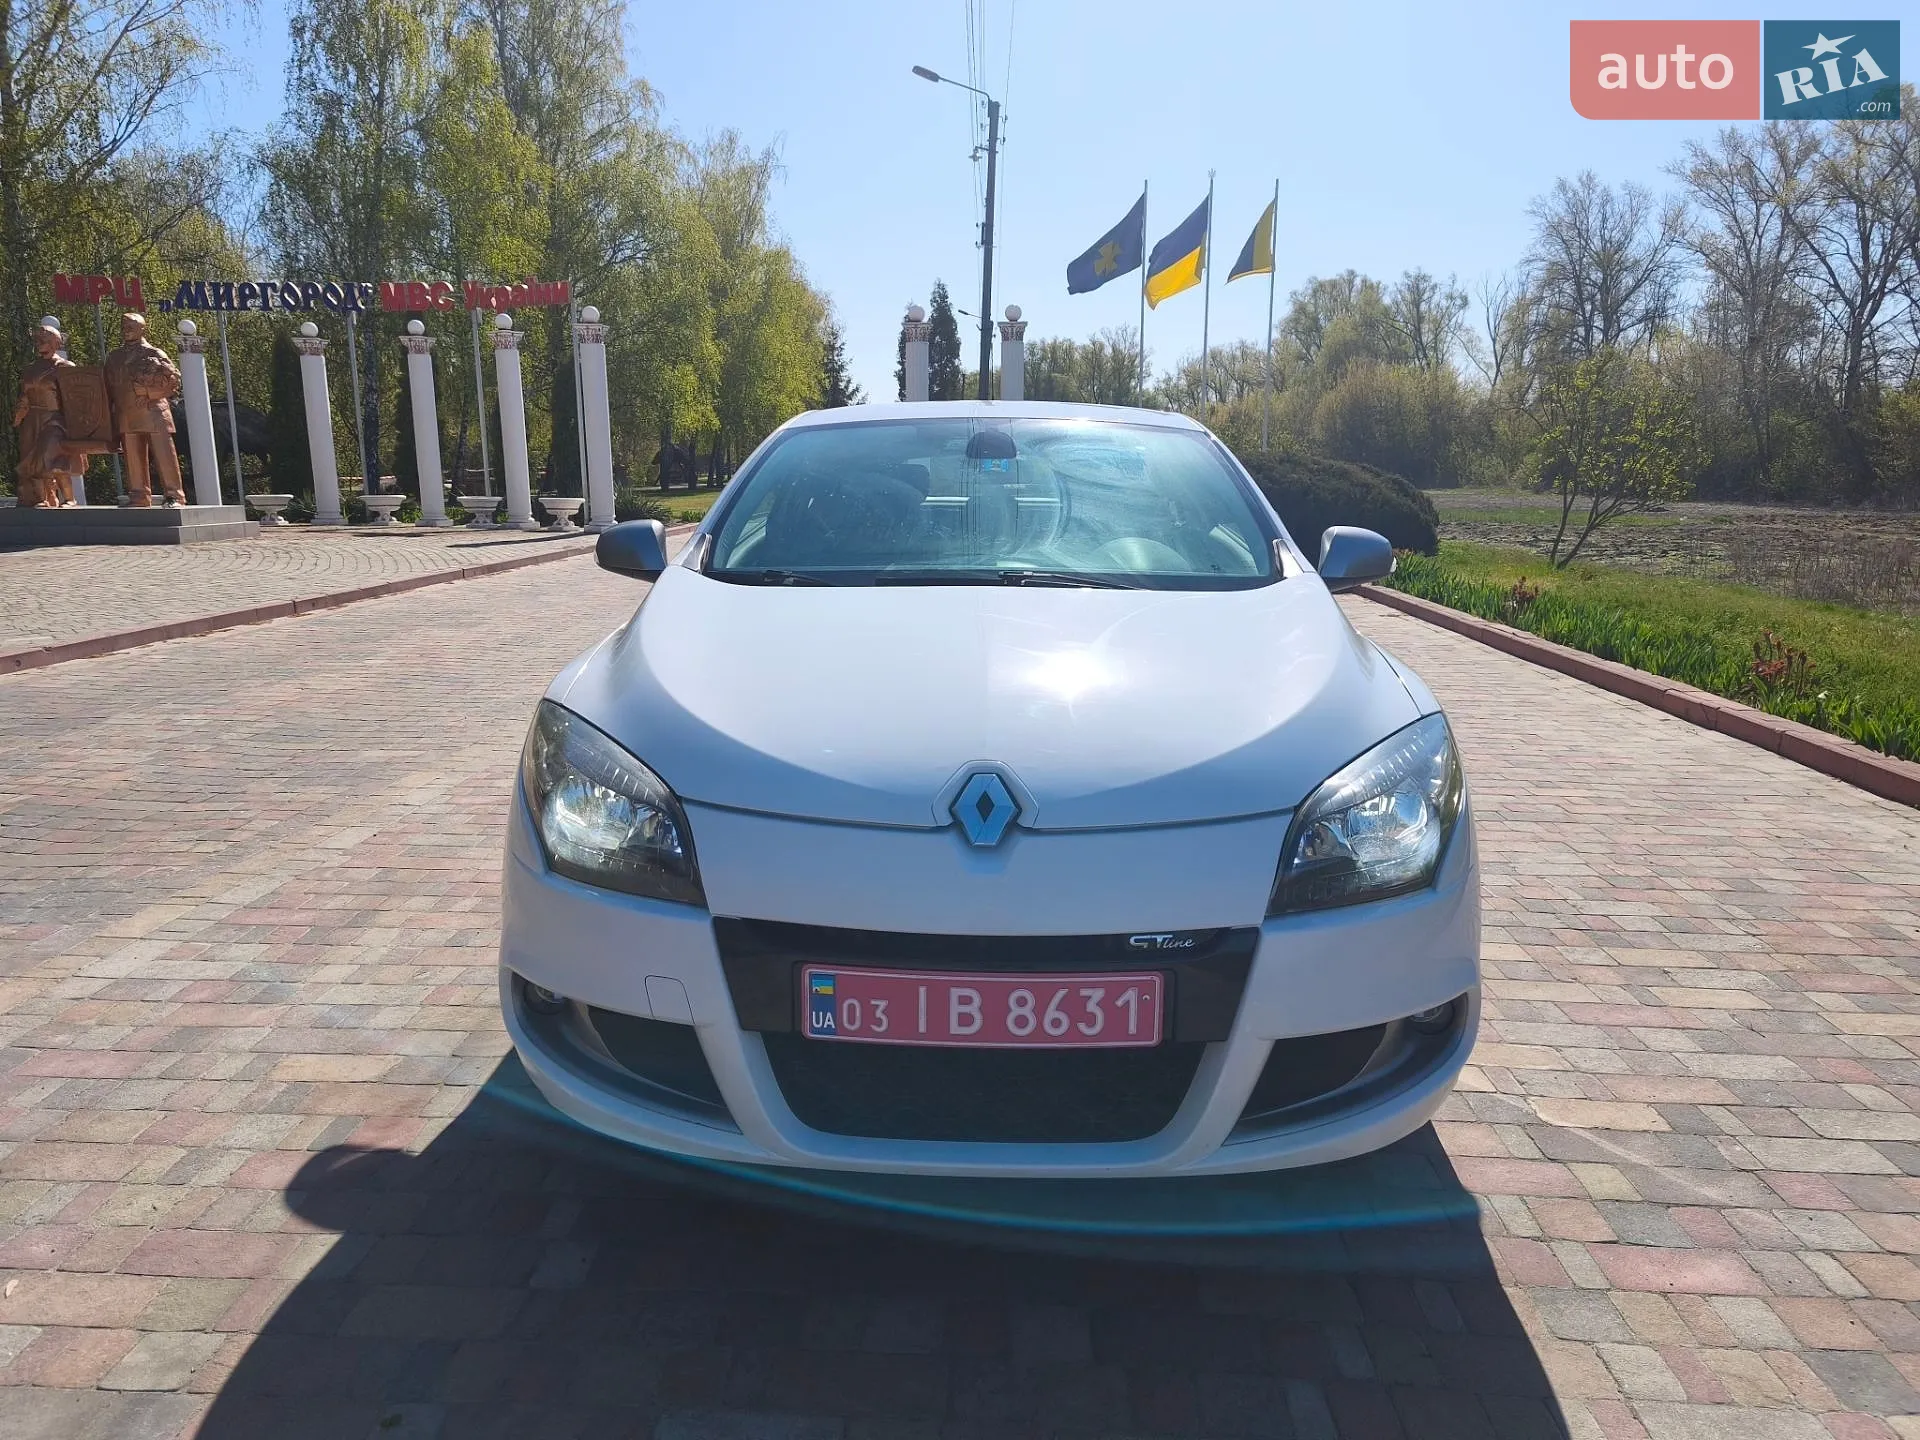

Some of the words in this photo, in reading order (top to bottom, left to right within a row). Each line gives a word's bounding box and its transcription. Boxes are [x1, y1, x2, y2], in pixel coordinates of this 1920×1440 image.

[53, 272, 146, 312] МРЦ
[380, 280, 455, 312] МВС
[812, 1011, 836, 1029] UA
[842, 998, 889, 1033] 03
[1006, 986, 1138, 1037] 8631
